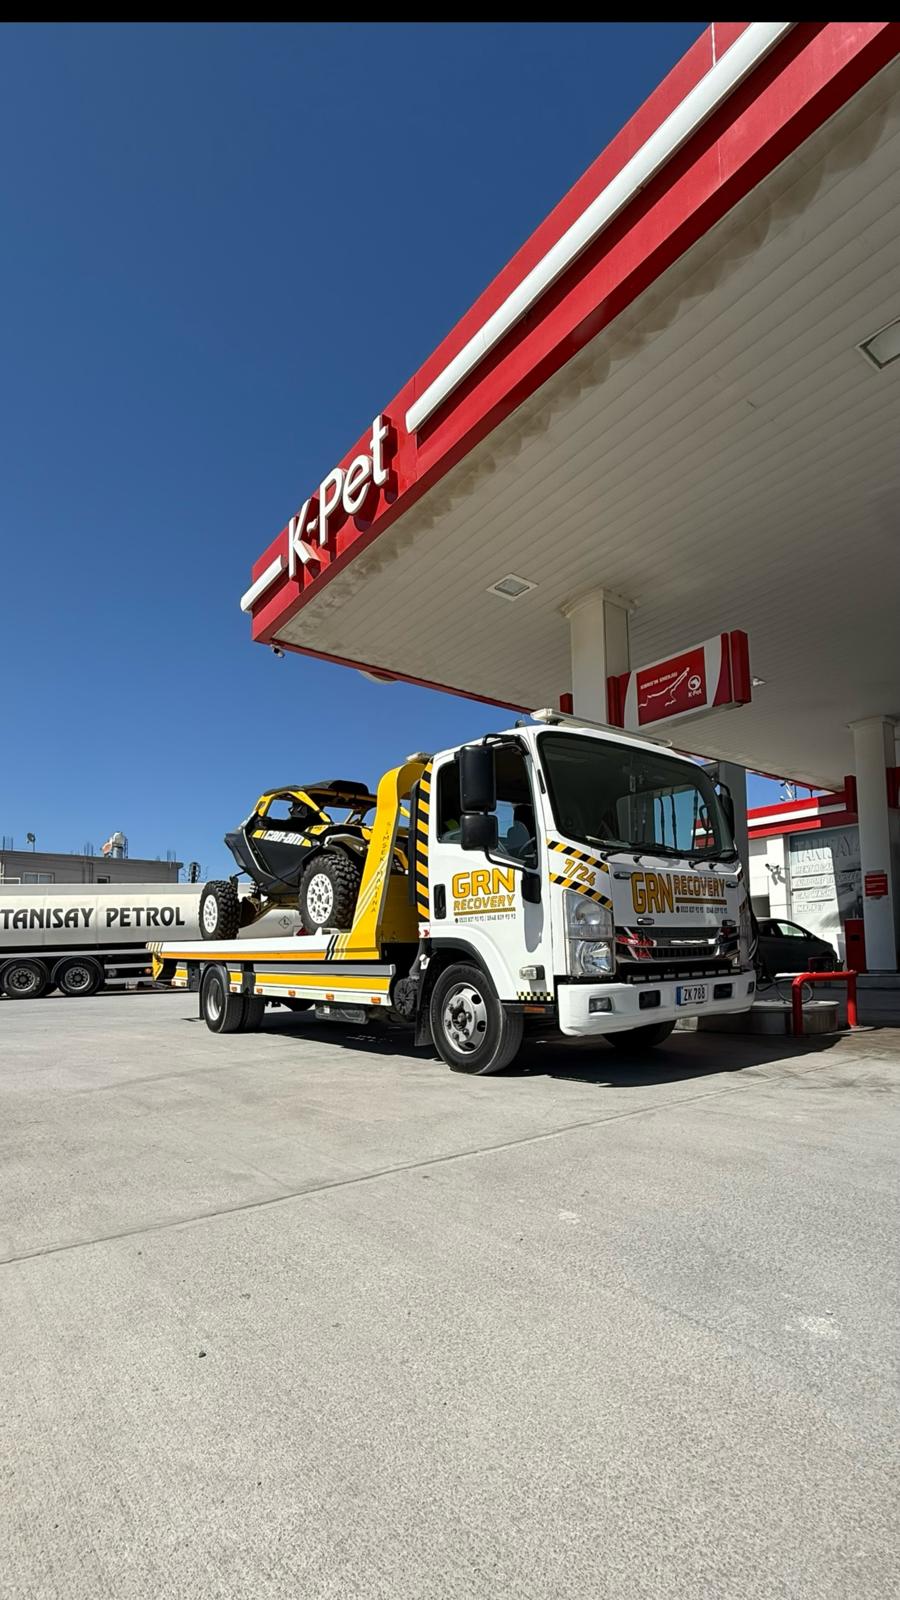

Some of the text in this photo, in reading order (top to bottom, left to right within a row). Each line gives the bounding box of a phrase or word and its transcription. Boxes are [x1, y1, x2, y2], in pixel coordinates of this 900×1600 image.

[288, 415, 389, 578] K-Pet
[452, 868, 516, 899] GRN
[563, 858, 597, 887] 7/24
[673, 875, 725, 897] RECOVERY
[453, 894, 516, 911] RECOVERY
[630, 872, 674, 914] GRN
[0, 906, 185, 930] TANISAY PETROL
